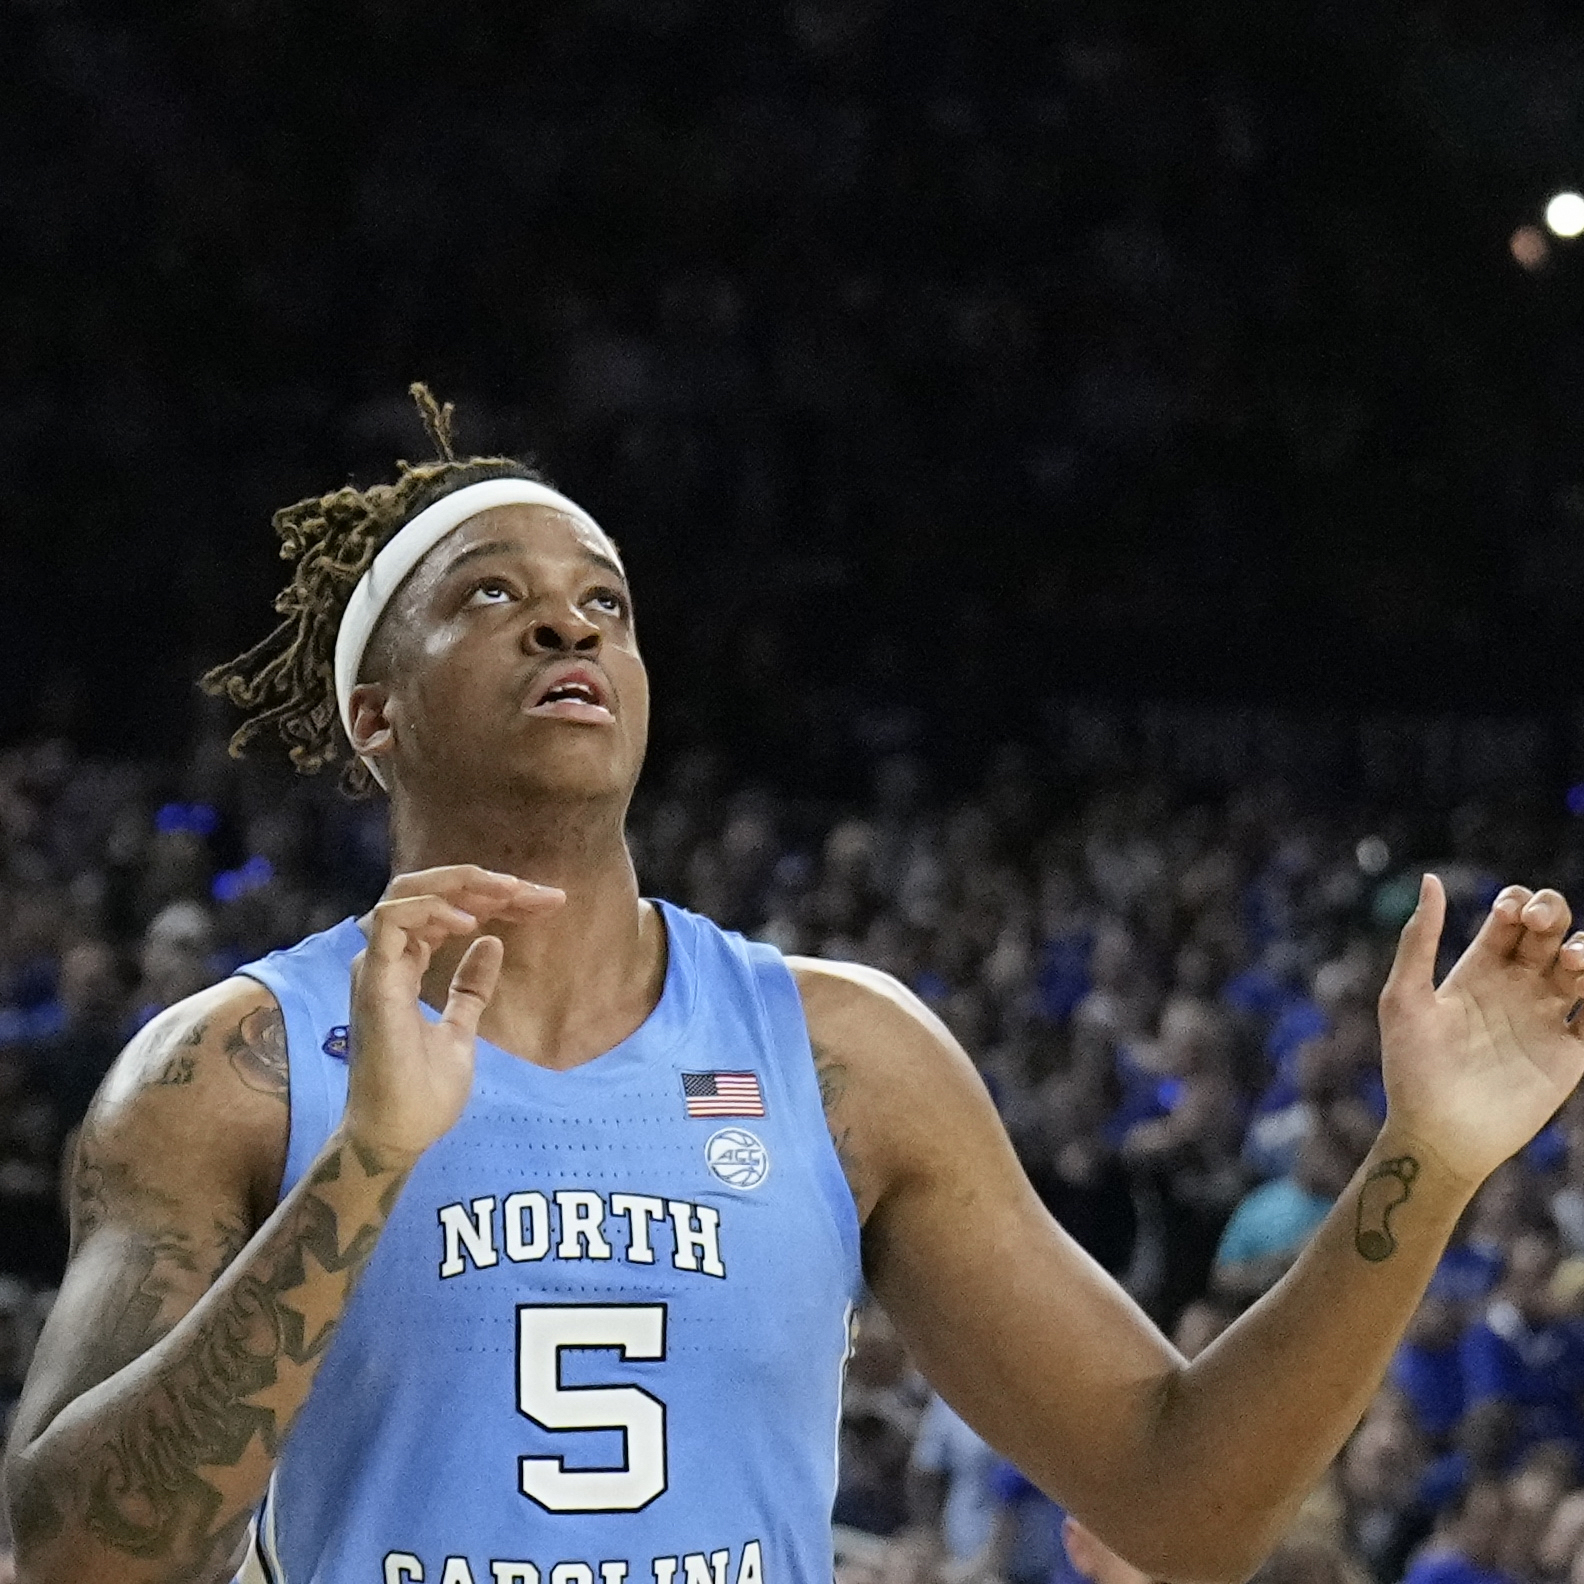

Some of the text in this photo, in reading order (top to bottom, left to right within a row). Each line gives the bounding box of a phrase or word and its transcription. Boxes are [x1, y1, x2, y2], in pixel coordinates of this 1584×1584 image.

[717, 1149, 762, 1166] ACC
[438, 1189, 727, 1279] NORTH
[515, 1303, 669, 1514] 5
